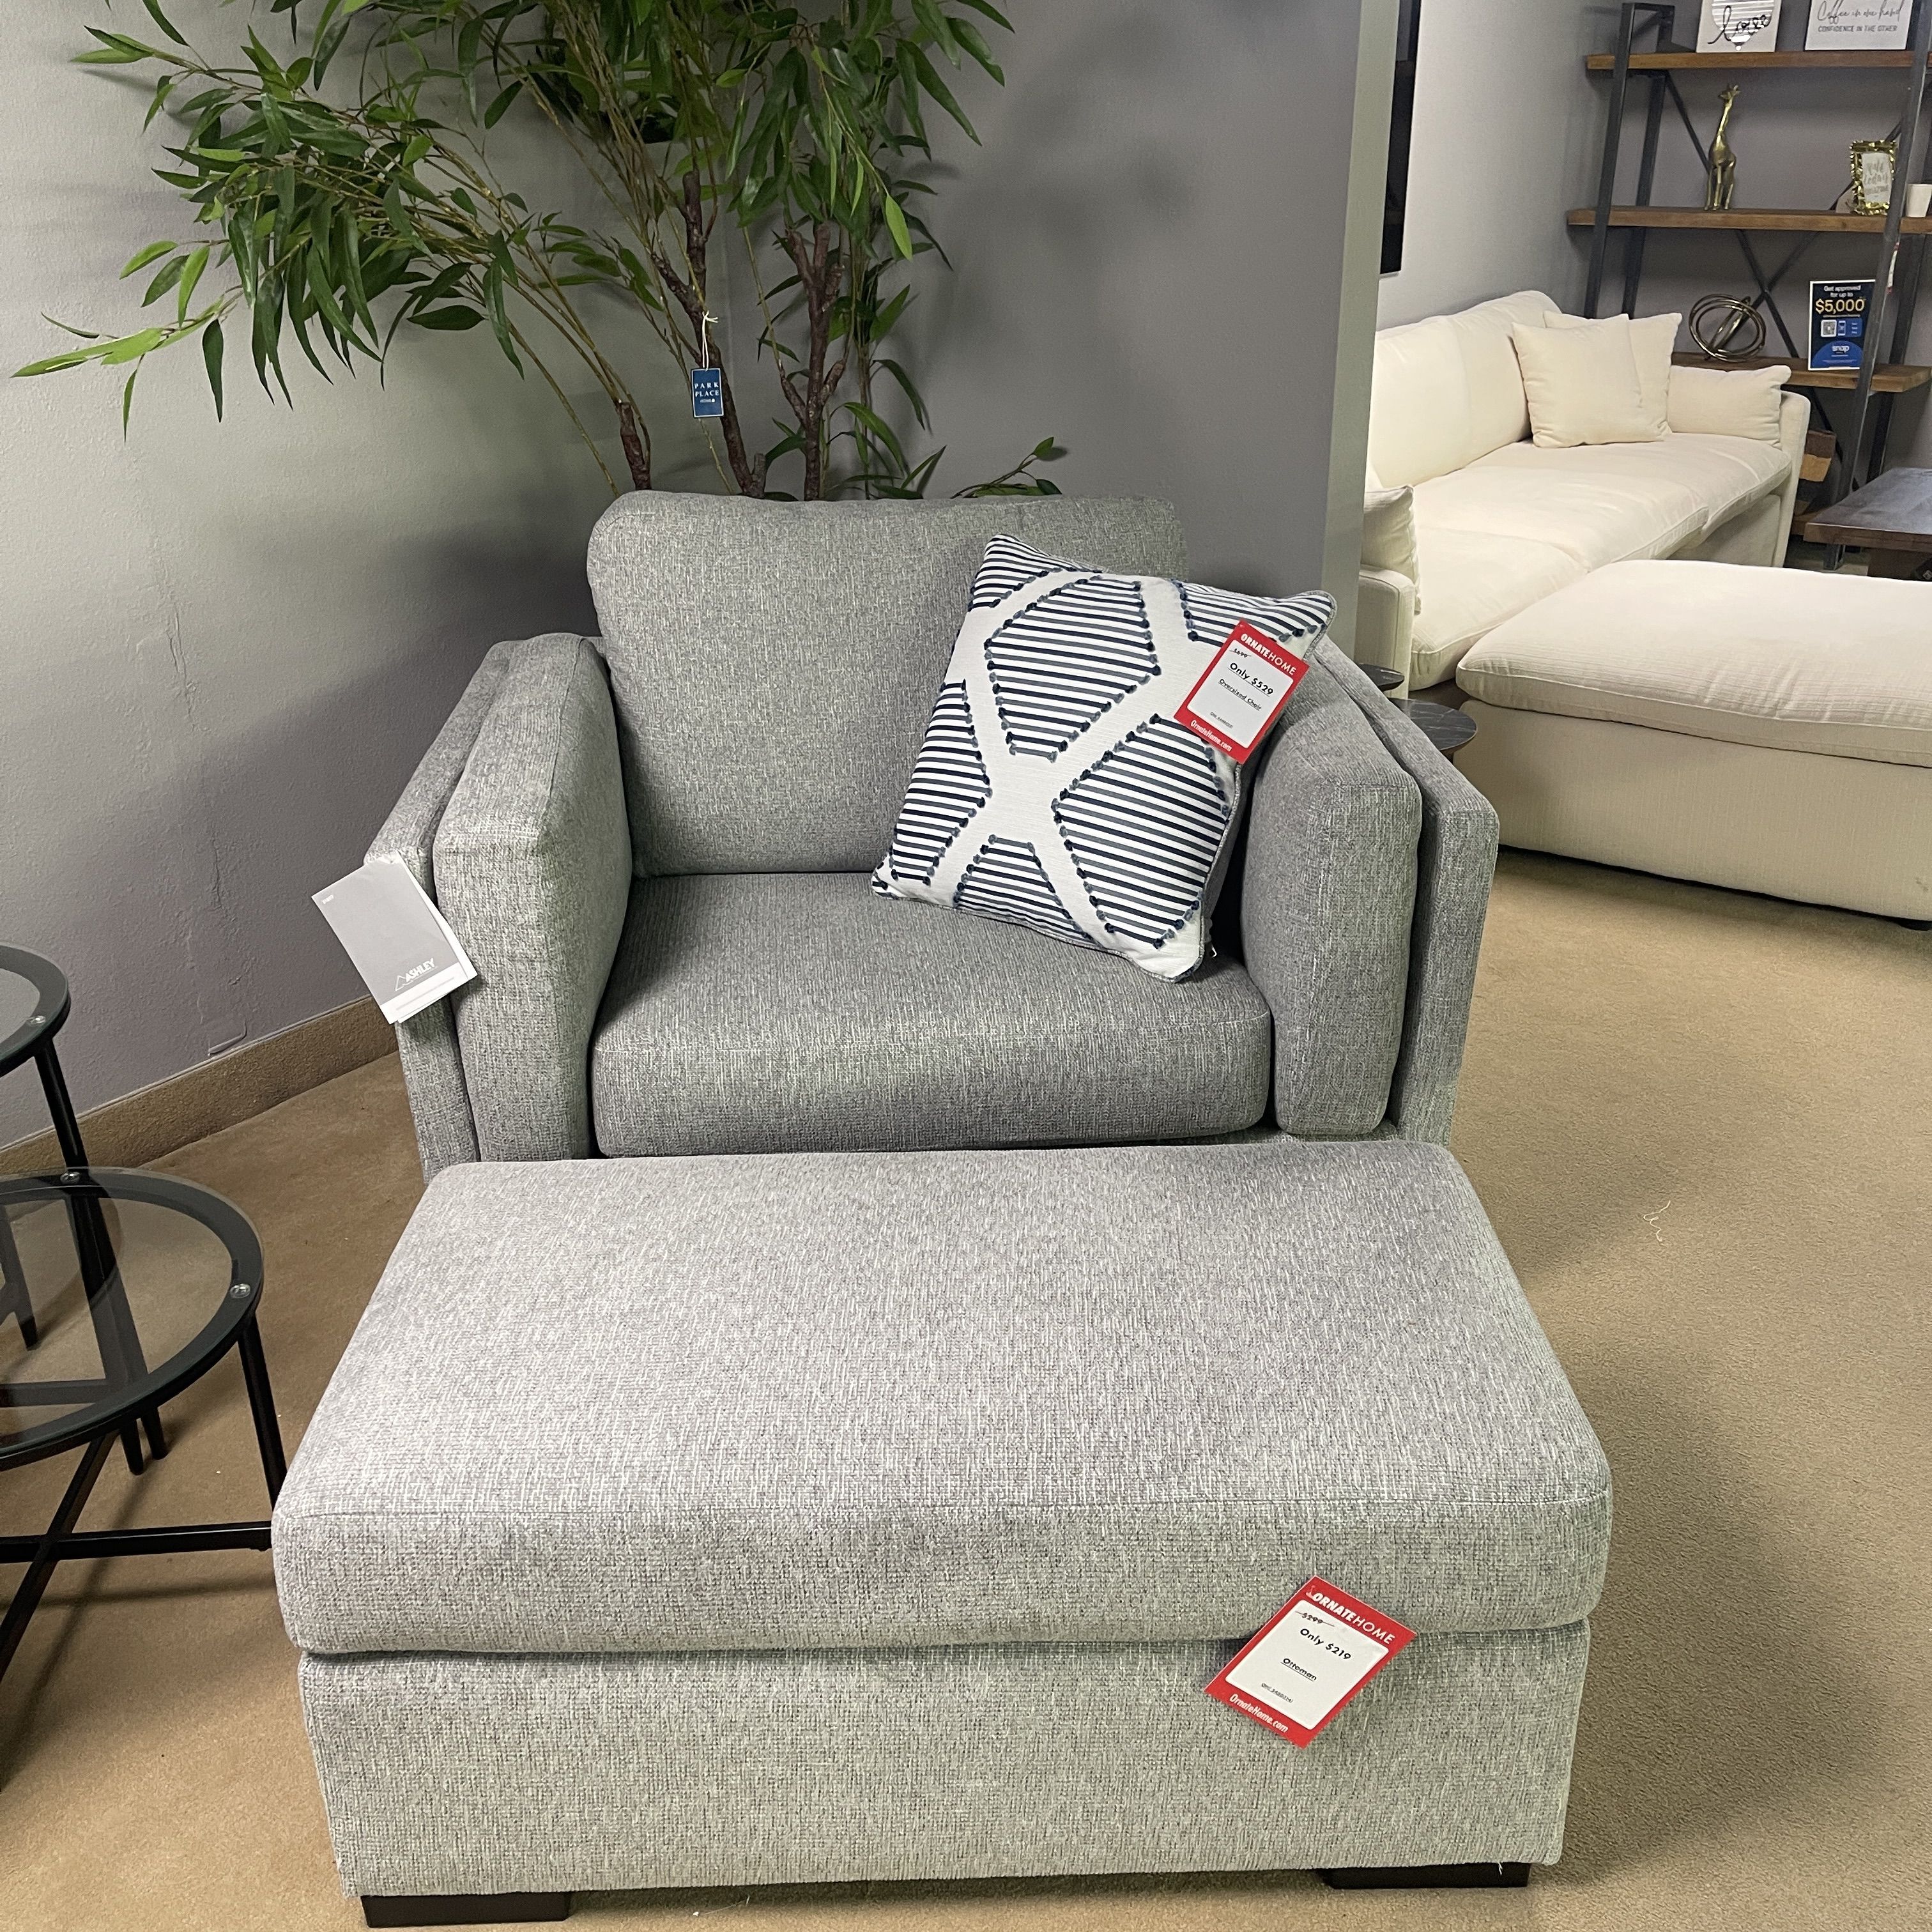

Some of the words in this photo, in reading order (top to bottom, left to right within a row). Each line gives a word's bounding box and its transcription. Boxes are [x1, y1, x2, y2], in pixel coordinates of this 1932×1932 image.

[1815, 298, 1865, 314] $5,000
[1219, 678, 1248, 702] Oversized
[1248, 698, 1262, 710] Chair
[1229, 662, 1250, 680] Only
[1251, 677, 1274, 695] $529
[1190, 719, 1232, 752] OrnateHome.com
[405, 958, 435, 983] ASHLEY
[1301, 1612, 1324, 1625] $299
[1300, 1628, 1325, 1646] Only
[1325, 1643, 1352, 1660] $219
[1282, 1657, 1317, 1682] Ottoman
[1229, 1693, 1289, 1733] OrnateHome.com
